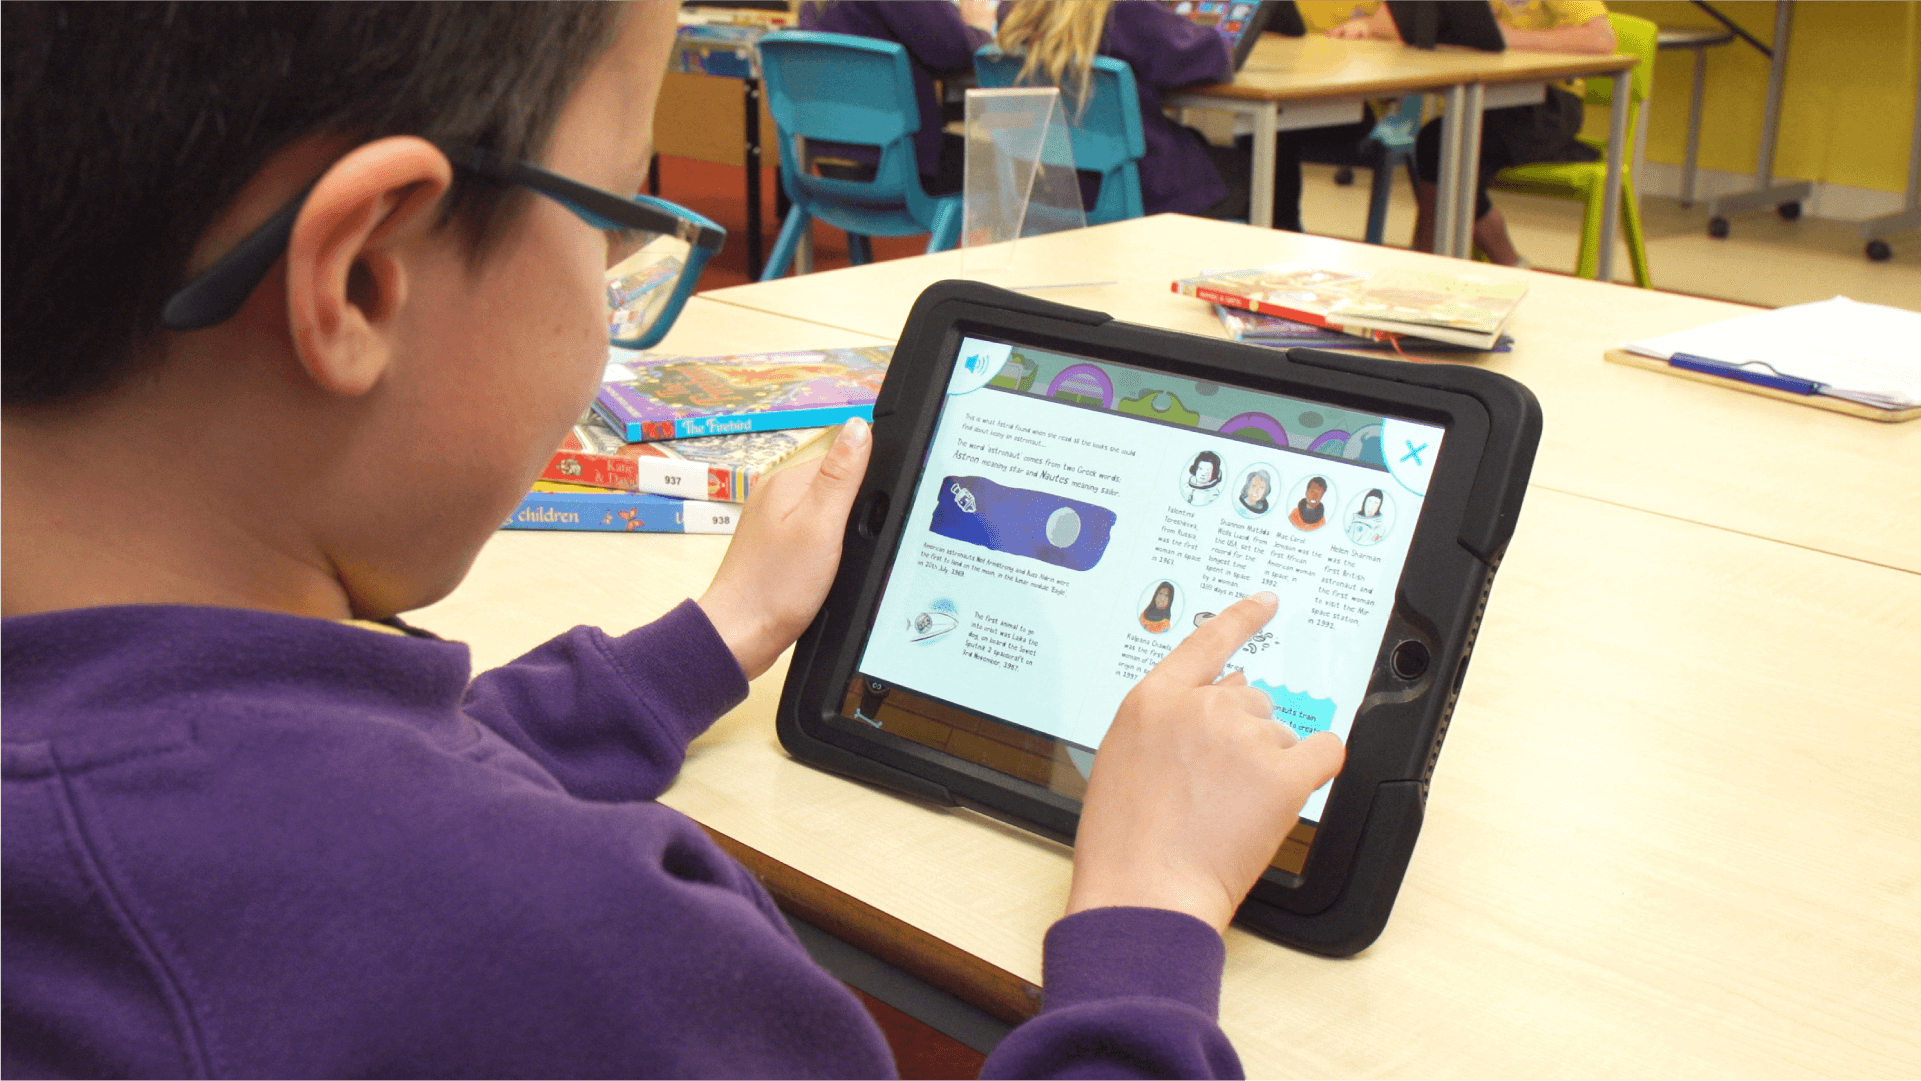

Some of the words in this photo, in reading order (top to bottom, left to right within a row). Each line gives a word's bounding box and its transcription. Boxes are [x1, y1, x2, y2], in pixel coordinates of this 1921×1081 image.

[681, 418, 705, 434] The
[706, 416, 752, 432] Firebird
[958, 438, 967, 446] The
[1024, 456, 1043, 464] comes
[1045, 458, 1060, 468] from
[1063, 463, 1075, 472] two
[1077, 466, 1097, 477] Greek
[953, 450, 980, 463] Astron
[982, 459, 1008, 472] meaning
[1010, 463, 1024, 474] star
[1026, 468, 1038, 477] and
[1040, 470, 1069, 484] Nautes
[1071, 481, 1098, 493] meaning
[665, 475, 681, 485] 937
[518, 506, 580, 523] children
[712, 516, 730, 524] 938
[1351, 549, 1381, 562] Sharman
[1321, 577, 1356, 590] astronaut
[1299, 711, 1317, 722] train
[1298, 725, 1320, 733] creat
